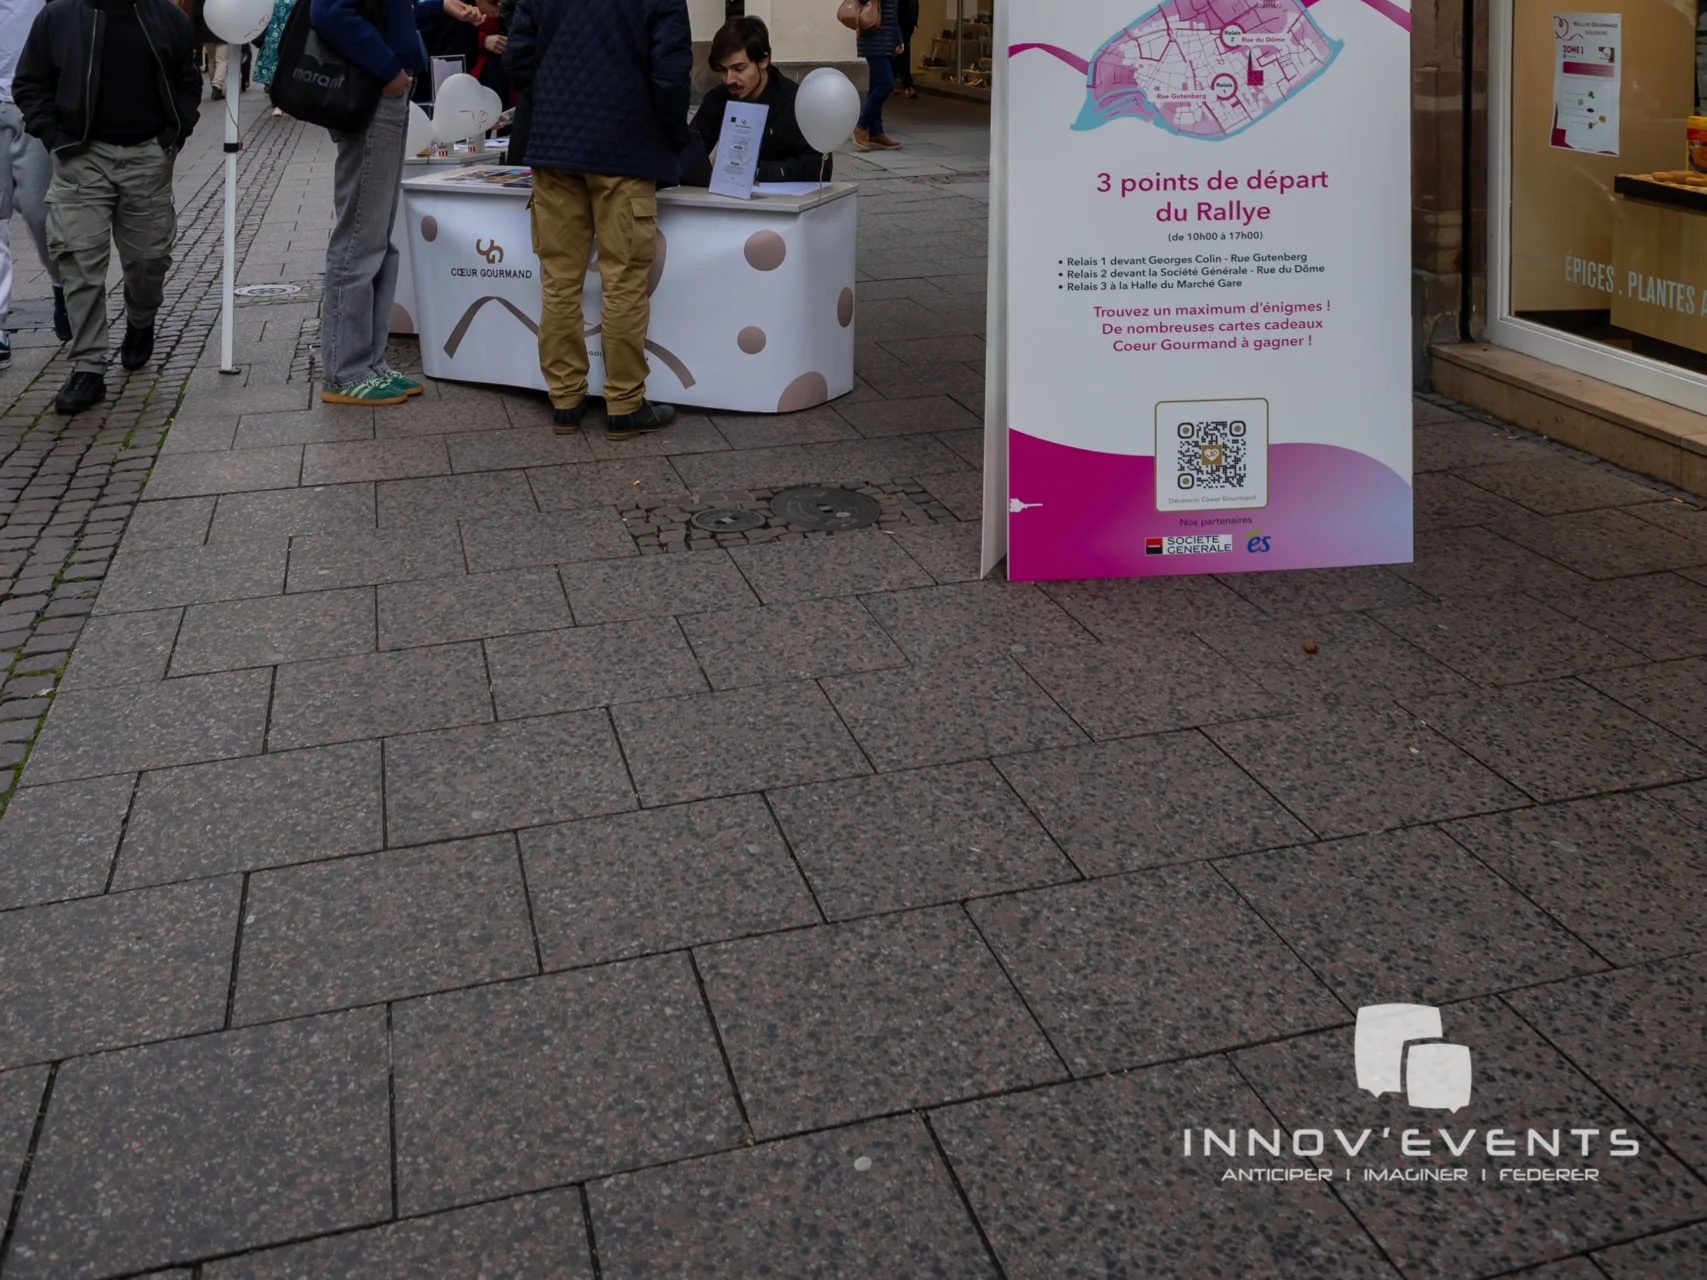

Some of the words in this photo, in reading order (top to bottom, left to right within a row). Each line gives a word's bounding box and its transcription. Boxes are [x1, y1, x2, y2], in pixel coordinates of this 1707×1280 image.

[1563, 45, 1579, 54] ZONE
[1581, 46, 1584, 54] 1
[292, 68, 345, 88] marant
[1097, 173, 1111, 192] 3
[1121, 172, 1199, 198] points
[1207, 170, 1238, 190] de
[1246, 169, 1328, 194] départ
[1156, 202, 1187, 222] du
[1197, 200, 1271, 226] Rallye
[1168, 232, 1184, 242] (de
[1187, 232, 1218, 241] 10h00
[1220, 231, 1226, 241] à
[1229, 231, 1263, 241] 17h00)
[1067, 257, 1098, 266] Relais
[1101, 257, 1106, 265] 1
[1110, 256, 1146, 265] devant
[1149, 256, 1193, 266] Georges
[1195, 254, 1221, 263] Colin
[1231, 254, 1250, 262] Rue
[1253, 253, 1307, 263] Gutenberg
[451, 268, 478, 278] CŒUR
[480, 269, 532, 279] GOURMAND
[1067, 270, 1098, 279] Relais
[1101, 269, 1107, 278] 2
[1110, 269, 1146, 278] devant
[1149, 268, 1157, 277] la
[1161, 267, 1198, 277] Société
[1201, 266, 1247, 276] Générale
[1257, 266, 1276, 274] Rue
[1279, 265, 1291, 273] du
[1294, 264, 1325, 273] Dôme
[1067, 282, 1098, 291] Relais
[1101, 282, 1107, 290] 3
[1110, 282, 1116, 290] à
[1120, 281, 1128, 290] la
[1131, 281, 1157, 290] Halle
[1161, 280, 1174, 289] du
[1177, 279, 1215, 289] Marché
[1218, 279, 1242, 288] Gare
[1565, 250, 1614, 293] ÉPICES
[1628, 271, 1695, 315] PLANTES
[1093, 306, 1149, 318] Trouvez
[1154, 307, 1170, 316] un
[1176, 303, 1245, 316] maximum
[1327, 300, 1330, 311] !
[1102, 323, 1122, 335] De
[1127, 321, 1214, 334] nombreuses
[1219, 320, 1260, 332] cartes
[1264, 318, 1323, 330] cadeaux
[1113, 341, 1156, 352] Coeur
[1161, 337, 1237, 351] Gourmand
[1241, 337, 1249, 348] à
[1253, 337, 1304, 350] gagner
[1308, 335, 1312, 346] !
[1169, 496, 1199, 504] Découvrir
[1180, 518, 1198, 526] Nos
[1201, 516, 1252, 527] partenaires
[1167, 535, 1219, 545] SOCIETE
[1167, 544, 1231, 554] GENERALE
